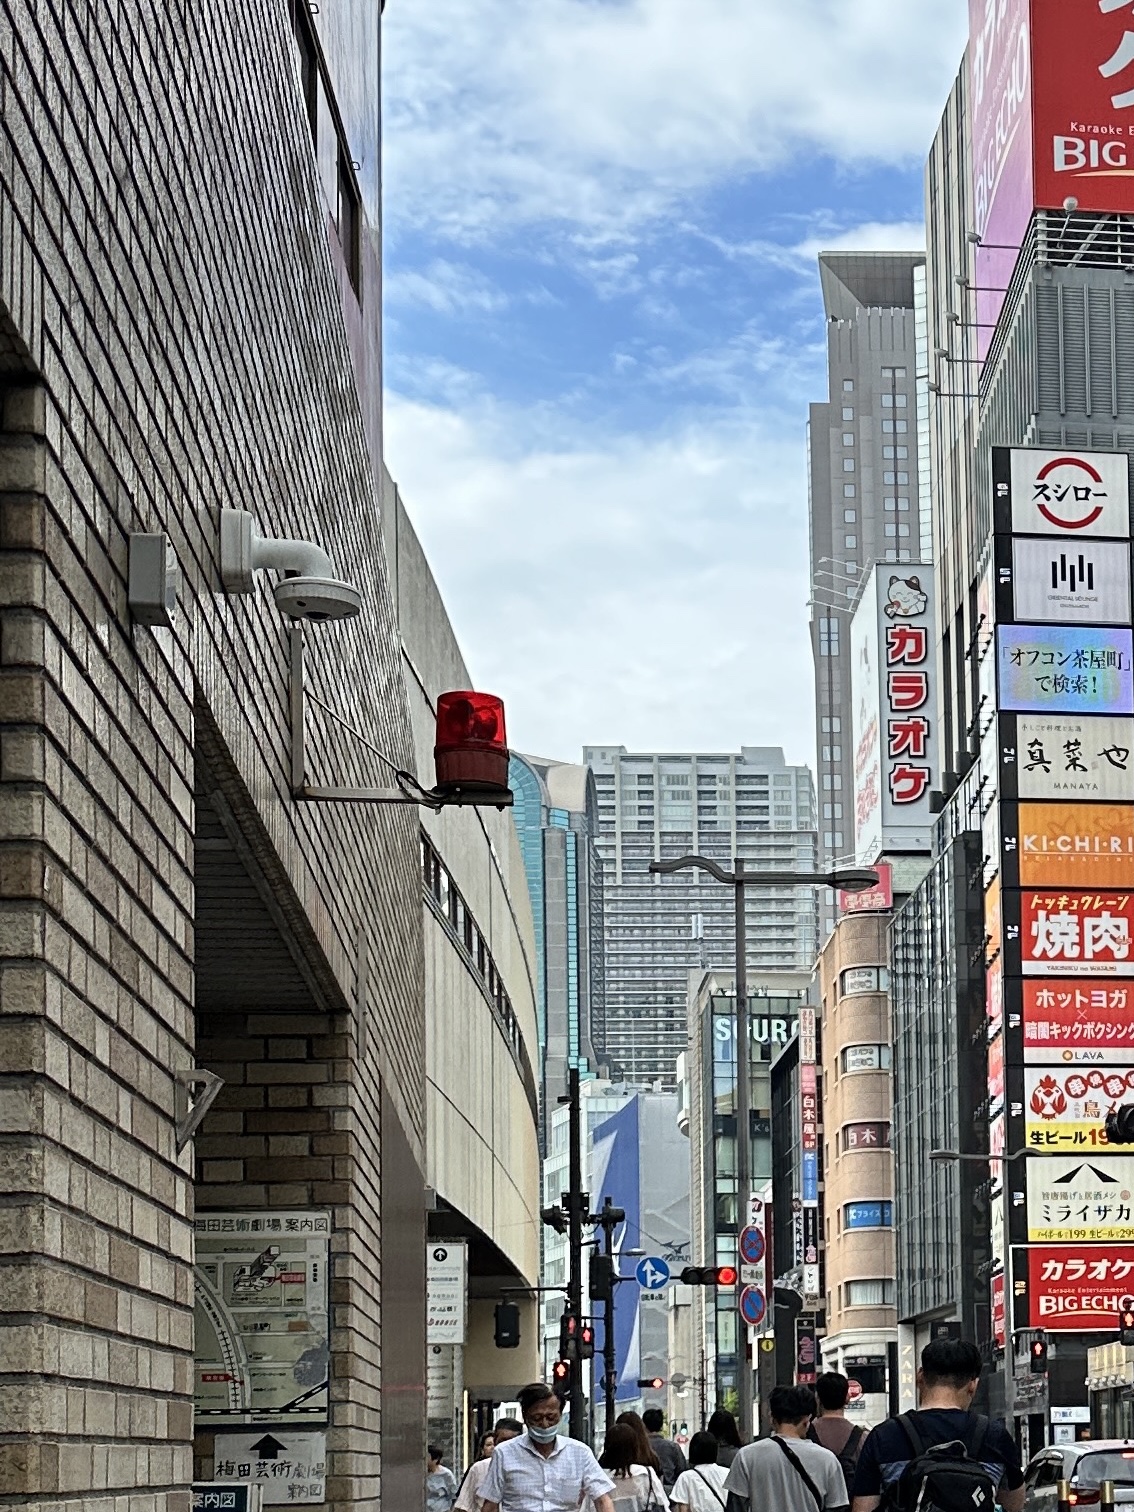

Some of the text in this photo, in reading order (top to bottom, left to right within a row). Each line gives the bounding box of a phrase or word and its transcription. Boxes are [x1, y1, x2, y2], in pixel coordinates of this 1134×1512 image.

[1070, 121, 1123, 135] Karaoke
[1053, 135, 1127, 172] BIG
[1031, 483, 1108, 502] スシロー
[885, 624, 931, 805] カラオケ
[1053, 782, 1099, 791] MANAYA
[1030, 909, 1130, 960] 焼肉
[1035, 988, 1128, 1009] ホットヨガ
[715, 1017, 800, 1043] SUR
[1075, 1052, 1105, 1060] LAVA
[848, 1127, 890, 1146] 白木
[1042, 1203, 1131, 1223] ミライザカ
[284, 1217, 328, 1232] 案内図
[1039, 1295, 1079, 1316] BIG
[901, 1344, 914, 1399] ZARA
[216, 1460, 326, 1480] 梅田芸術劇場
[287, 1483, 323, 1499] 案内図
